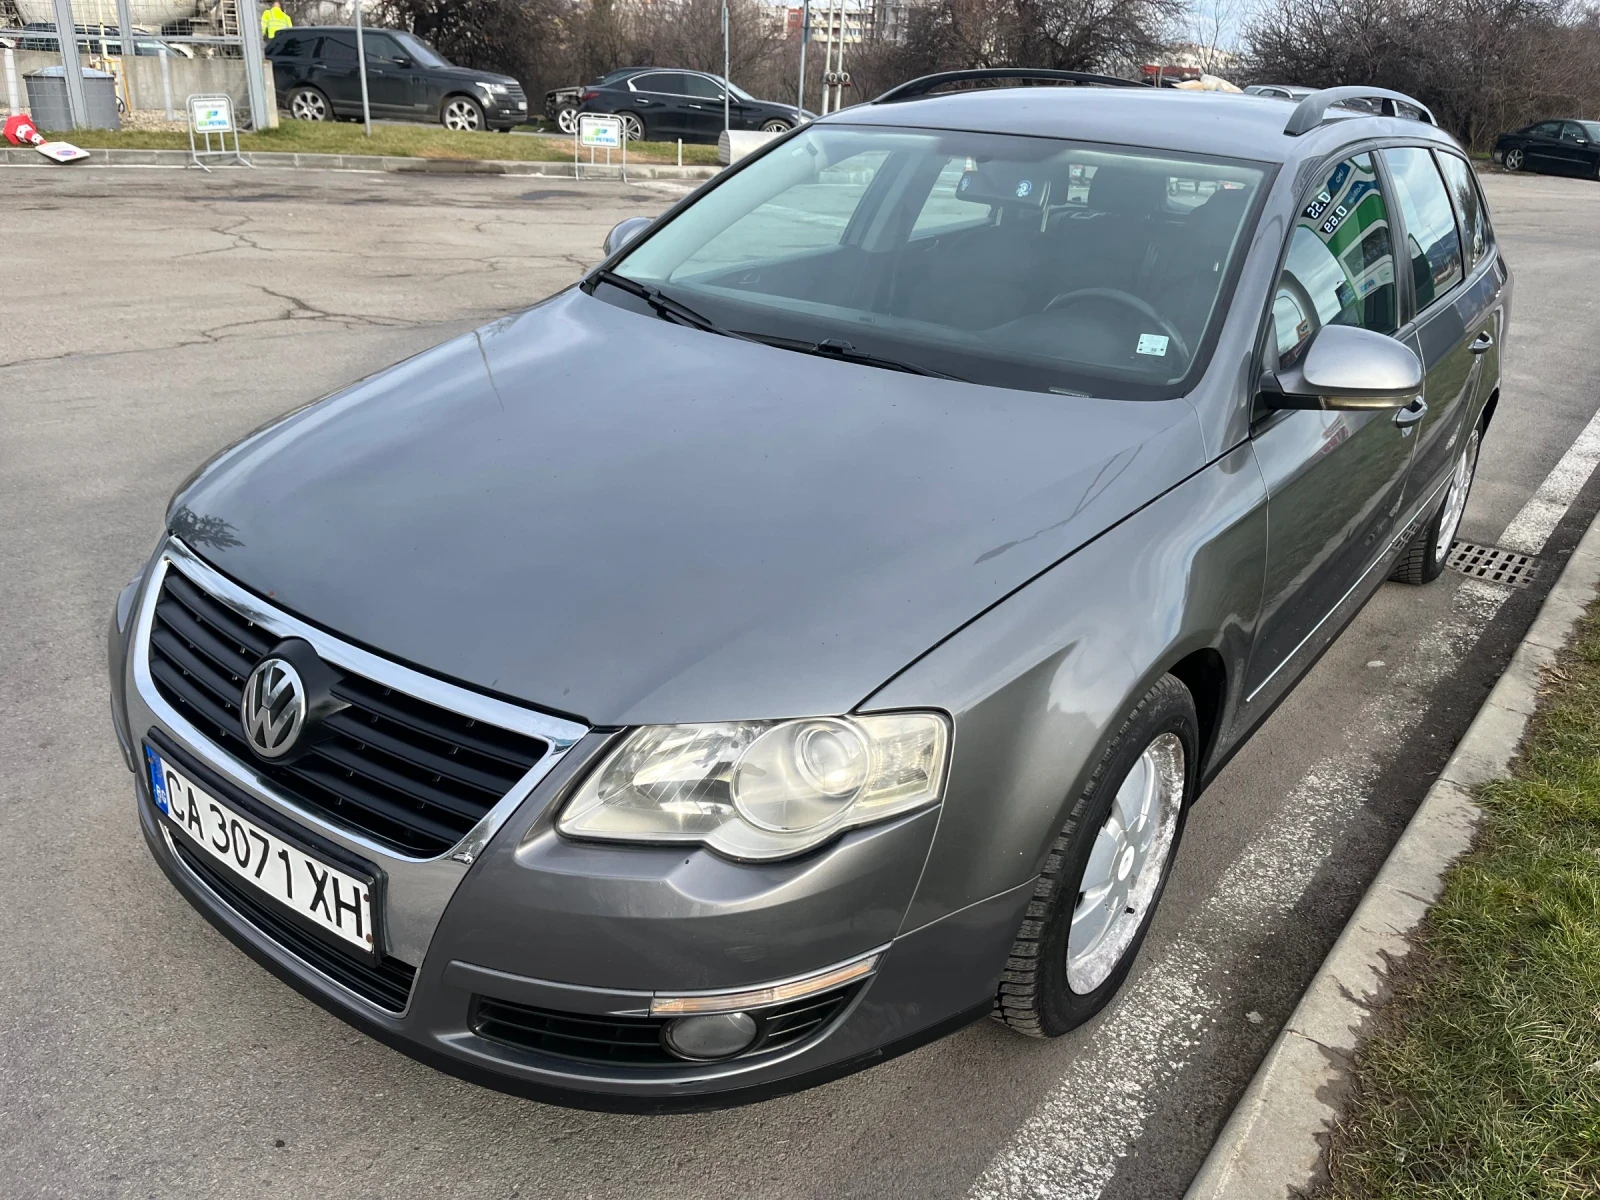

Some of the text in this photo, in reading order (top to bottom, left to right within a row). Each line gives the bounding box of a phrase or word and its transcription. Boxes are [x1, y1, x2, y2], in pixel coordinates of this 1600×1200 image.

[155, 784, 167, 804] BG
[166, 770, 364, 939] CA 3071 XH
